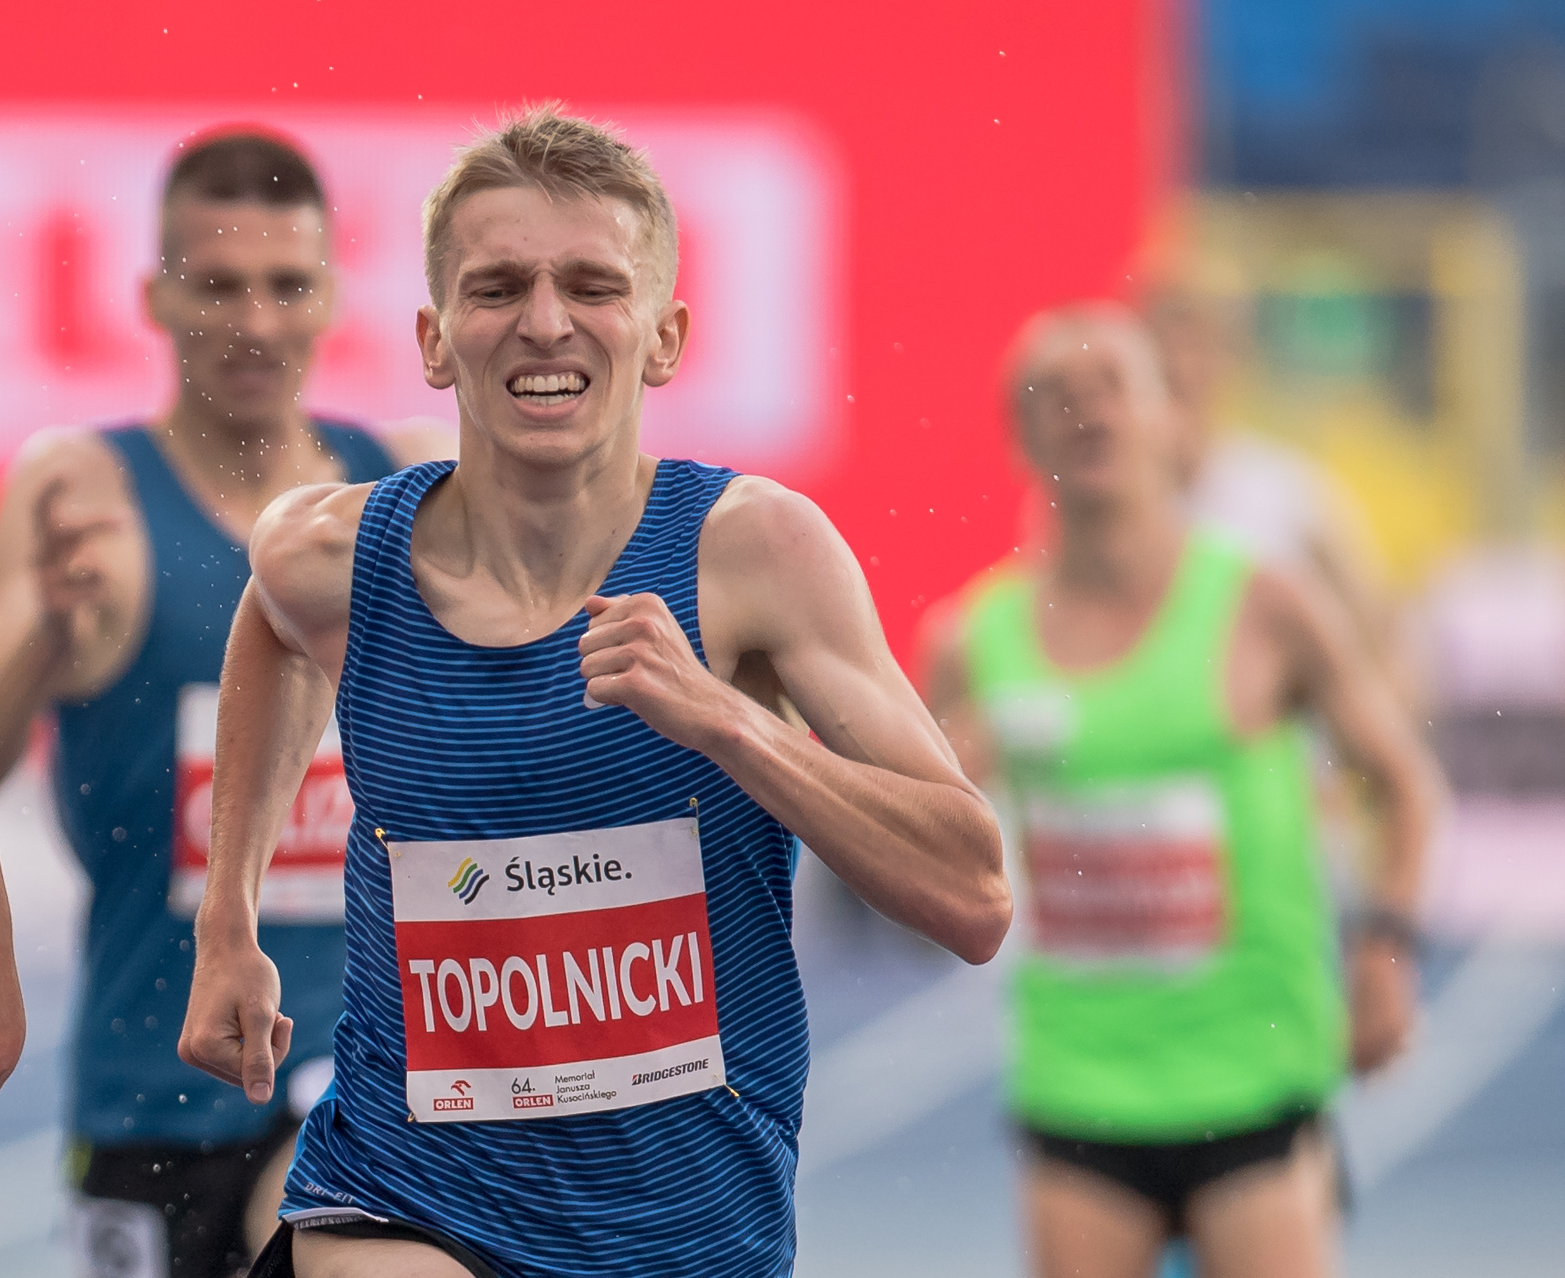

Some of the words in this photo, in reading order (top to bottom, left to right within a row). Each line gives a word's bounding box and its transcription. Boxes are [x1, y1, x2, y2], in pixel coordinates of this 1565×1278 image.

[505, 853, 633, 896] Śląskie.
[408, 931, 704, 1033] TOPOLNICKI
[631, 1058, 709, 1086] BRIDGESTONE
[511, 1077, 536, 1095] 64.
[556, 1083, 590, 1095] Janusza
[435, 1099, 472, 1110] ORLEN
[514, 1096, 552, 1108] ORLEN
